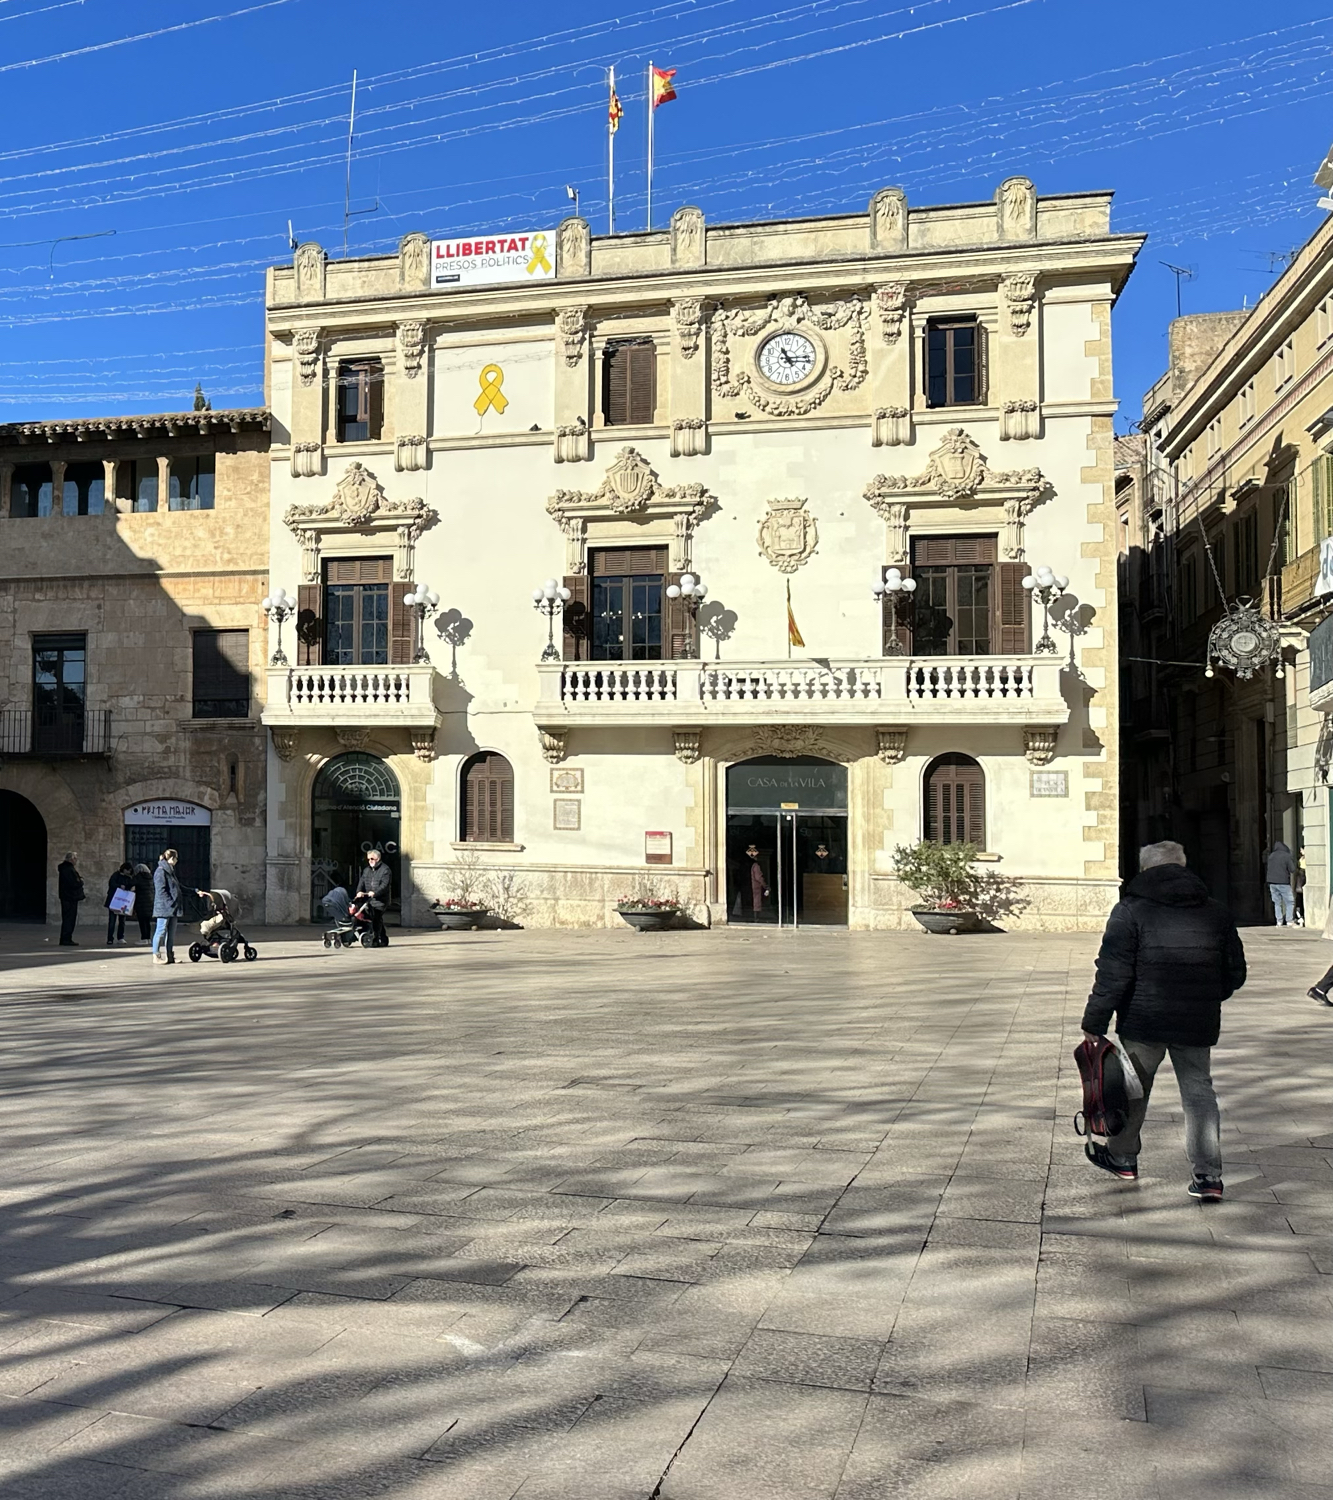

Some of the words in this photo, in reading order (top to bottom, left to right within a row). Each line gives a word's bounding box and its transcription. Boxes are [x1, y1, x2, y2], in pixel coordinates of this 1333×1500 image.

[436, 237, 529, 259] LLIBERTAT
[435, 259, 477, 272] PRESOS
[481, 254, 529, 268] POLÍTICS
[747, 777, 778, 787] CASA
[798, 777, 826, 788] VILA
[169, 805, 196, 815] MAJOR
[361, 840, 397, 854] OAC
